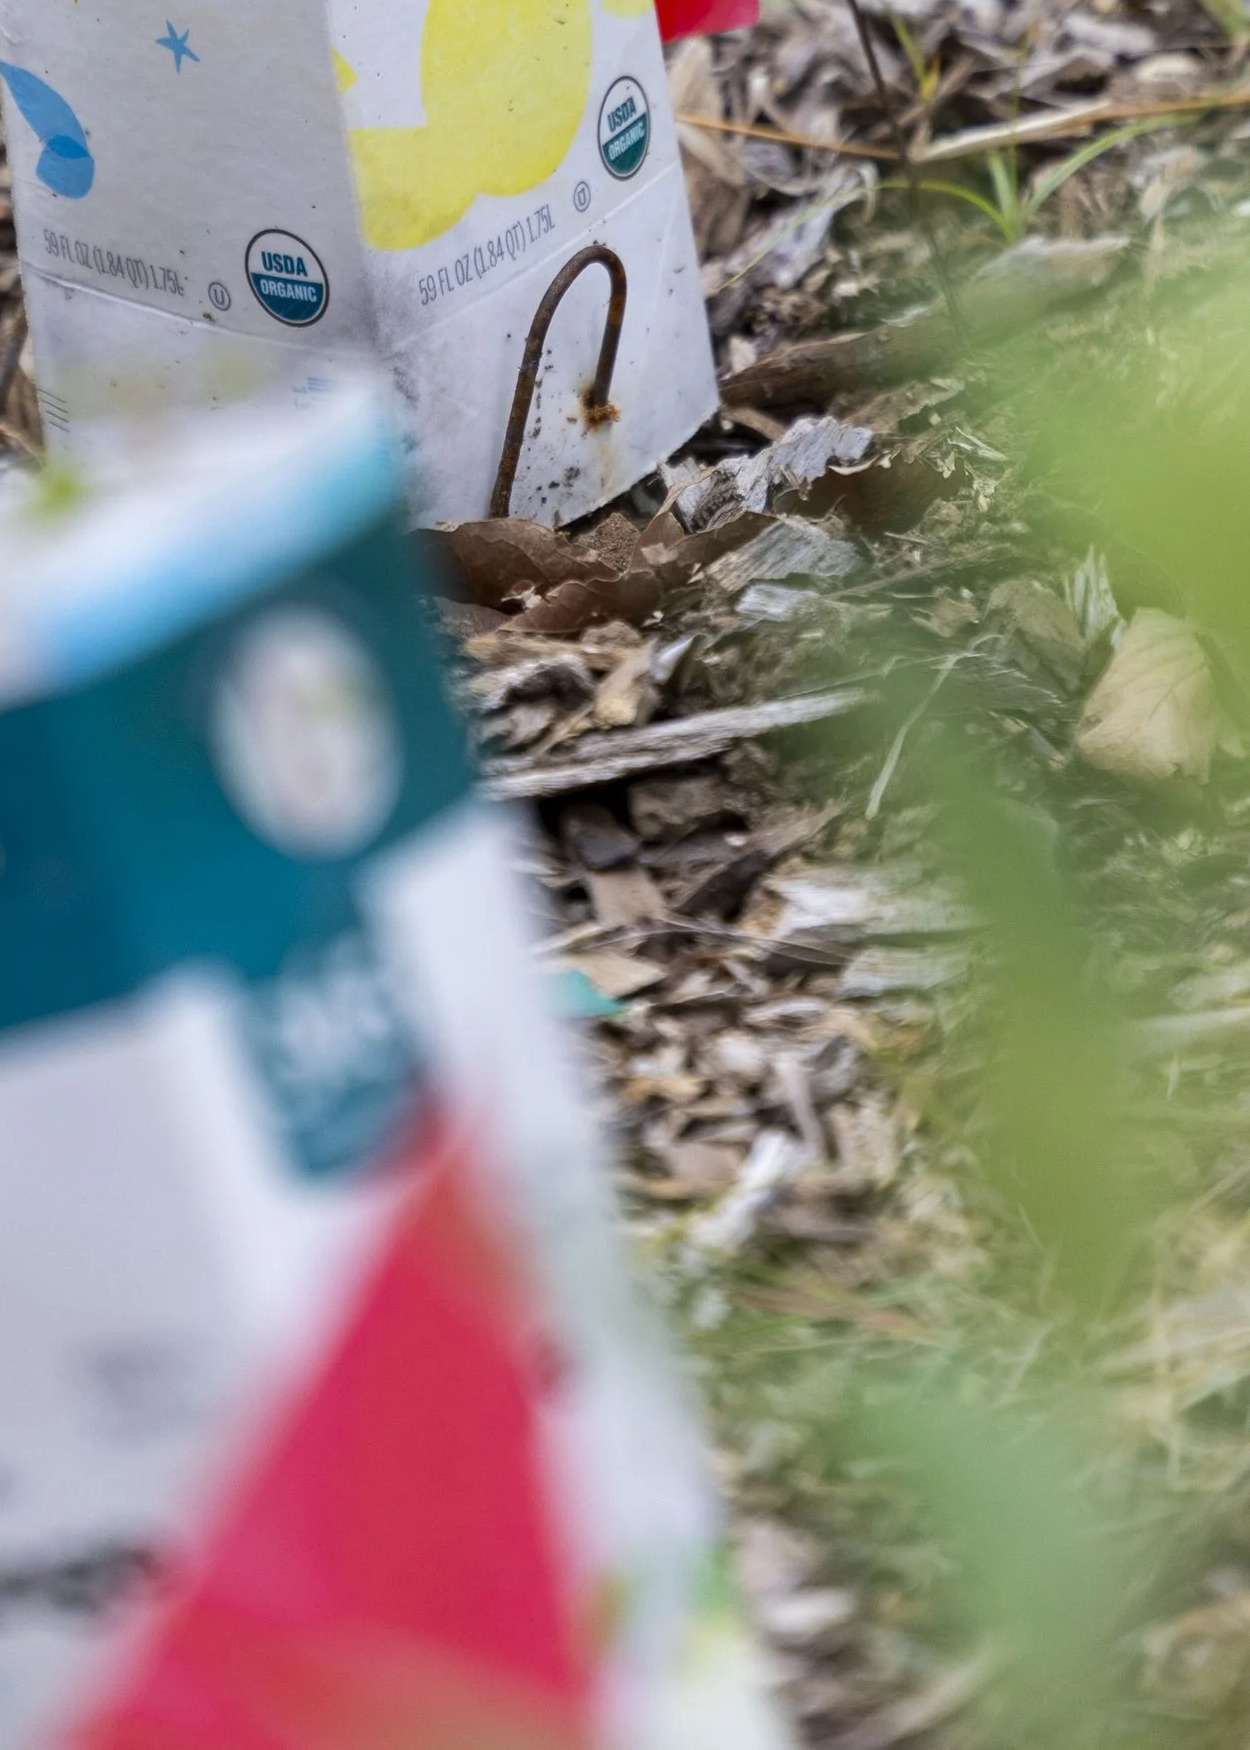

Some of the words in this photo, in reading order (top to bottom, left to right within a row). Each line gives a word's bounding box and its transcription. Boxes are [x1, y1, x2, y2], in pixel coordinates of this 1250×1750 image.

[607, 96, 637, 133] USDA
[607, 120, 646, 162] ORGANIC
[261, 251, 308, 278] USDA
[418, 274, 437, 306] 59
[438, 263, 455, 297] FL
[454, 253, 475, 288] OZ
[504, 221, 526, 262] QT)
[259, 277, 317, 303] ORGANIC
